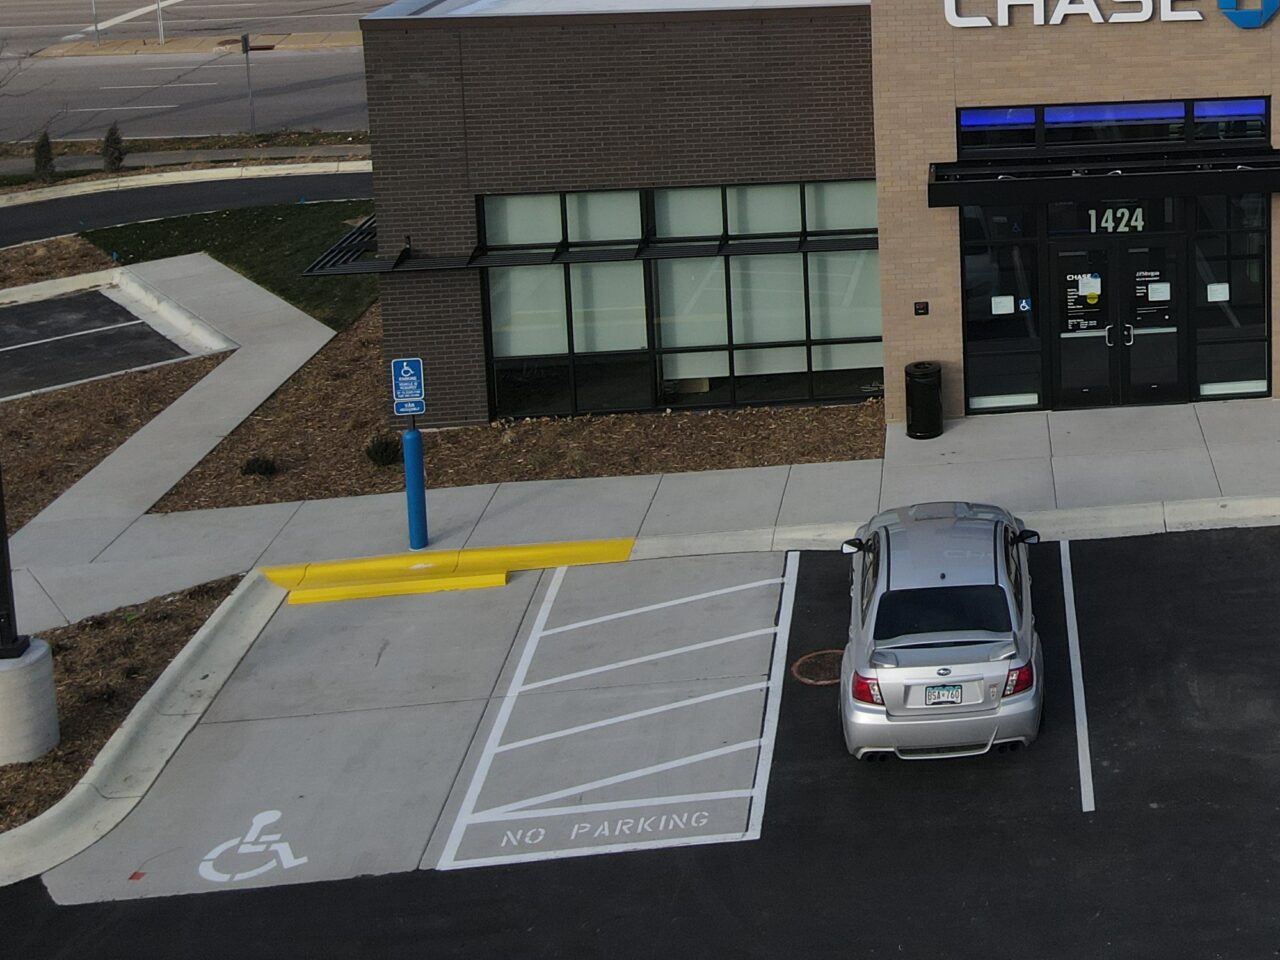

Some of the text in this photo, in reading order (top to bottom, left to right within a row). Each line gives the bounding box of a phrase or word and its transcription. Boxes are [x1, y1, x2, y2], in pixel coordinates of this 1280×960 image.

[1088, 208, 1145, 233] 1424
[501, 811, 710, 848] NO PARKING
